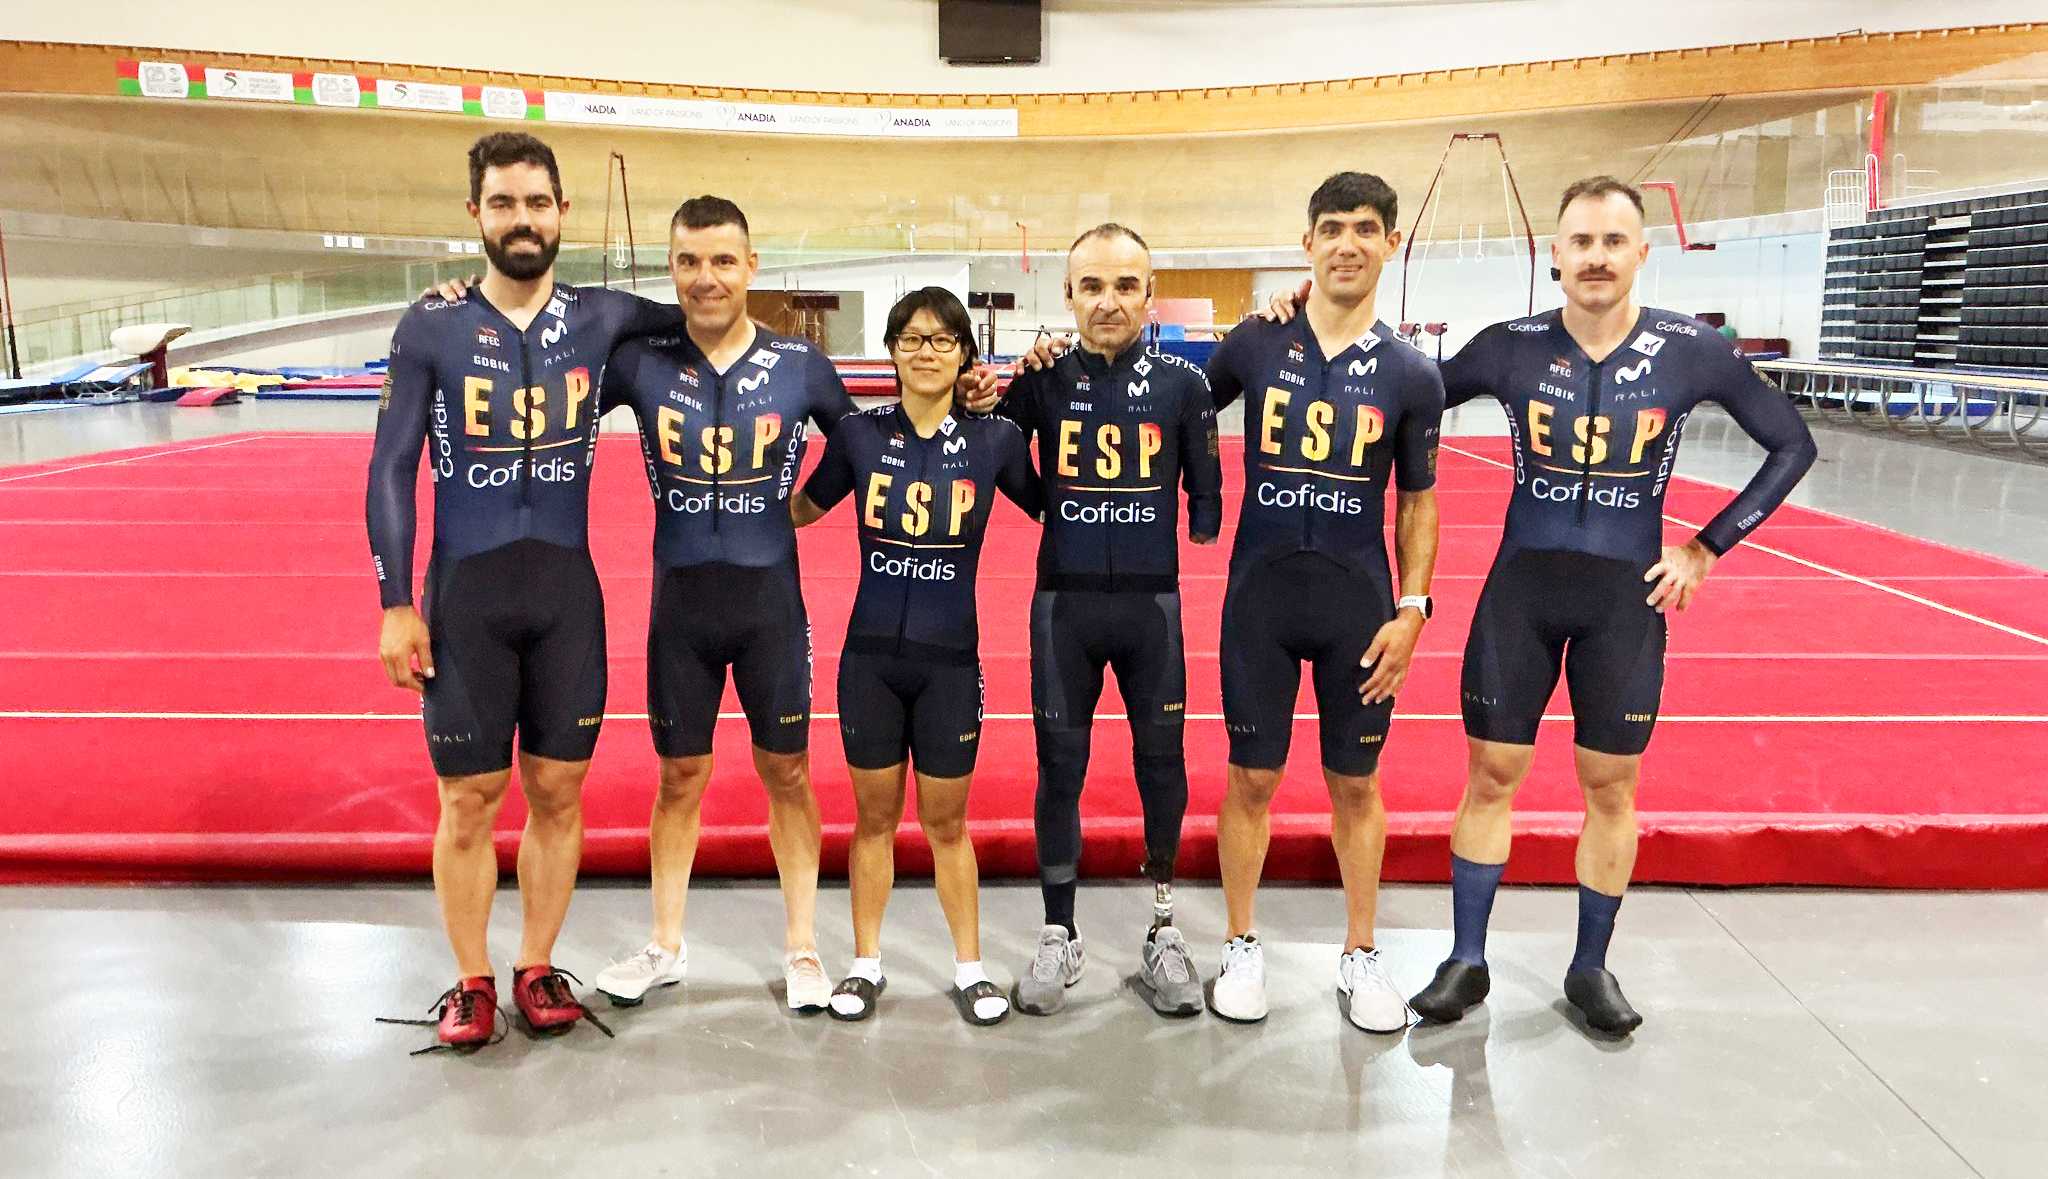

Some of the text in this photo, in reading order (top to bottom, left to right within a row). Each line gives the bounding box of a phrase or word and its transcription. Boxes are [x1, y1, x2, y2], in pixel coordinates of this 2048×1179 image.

[738, 112, 776, 123] ANADIA
[893, 118, 931, 128] ANADIA
[1508, 323, 1550, 333] Cofidis
[1655, 321, 1698, 337] Cofidis
[770, 341, 809, 353] Cofidis
[473, 355, 510, 373] GOBIK
[1279, 369, 1306, 387] GOBIK
[669, 390, 703, 412] GOBIK
[1538, 382, 1575, 402] GOBIK
[1070, 401, 1093, 412] GOBIK
[434, 389, 454, 478] Cofidis
[778, 421, 804, 501] Cofidis
[468, 457, 576, 489] Cofidis
[668, 489, 766, 514] Cofidis
[1257, 482, 1362, 515] Cofidis
[1531, 478, 1640, 509] Cofidis
[1060, 500, 1156, 524] Cofidis
[870, 551, 956, 580] Cofidis
